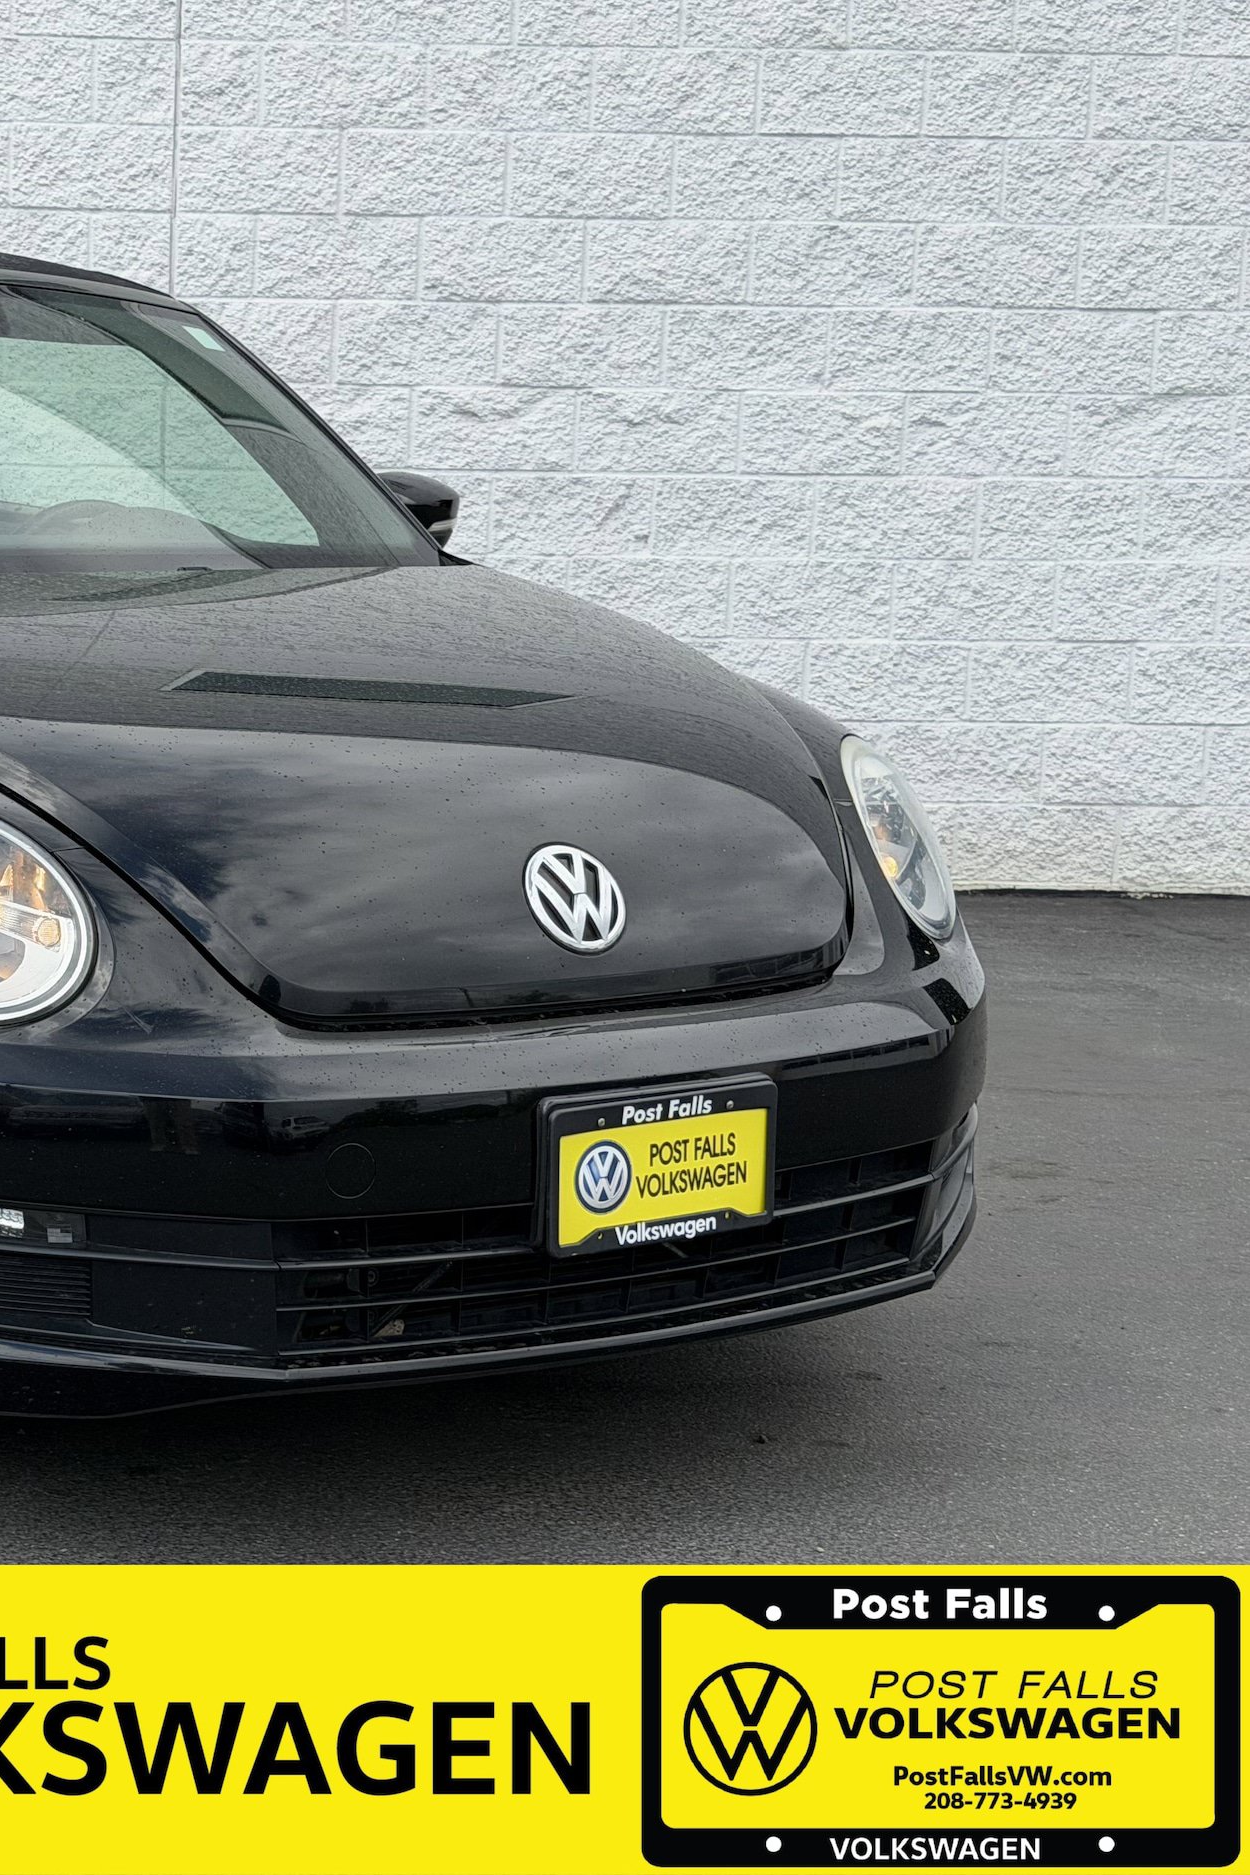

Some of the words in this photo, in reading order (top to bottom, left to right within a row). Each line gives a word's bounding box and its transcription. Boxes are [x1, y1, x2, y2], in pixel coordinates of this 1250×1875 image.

[622, 1103, 664, 1126] Post
[668, 1094, 713, 1119] Falls
[649, 1138, 691, 1168] POST
[694, 1131, 737, 1159] FALLS
[635, 1160, 748, 1199] VOLKSWAGEN
[614, 1215, 717, 1246] Volkswagen
